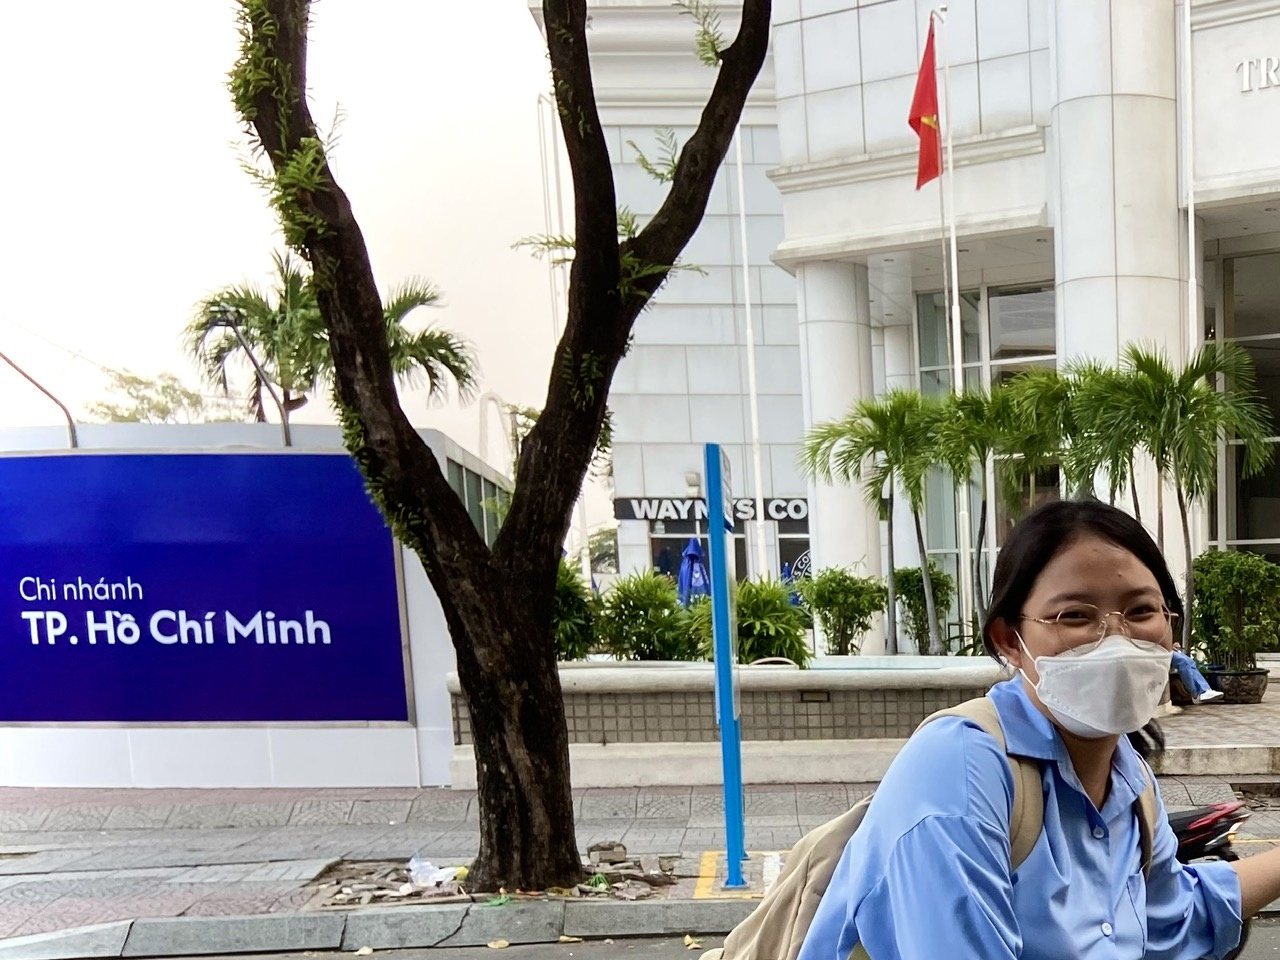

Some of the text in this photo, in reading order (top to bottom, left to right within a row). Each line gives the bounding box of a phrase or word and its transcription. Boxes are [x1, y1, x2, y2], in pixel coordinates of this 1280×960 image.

[19, 575, 143, 601] Chi nhánh
[21, 609, 331, 645] TP. Hồ Chí Minh
